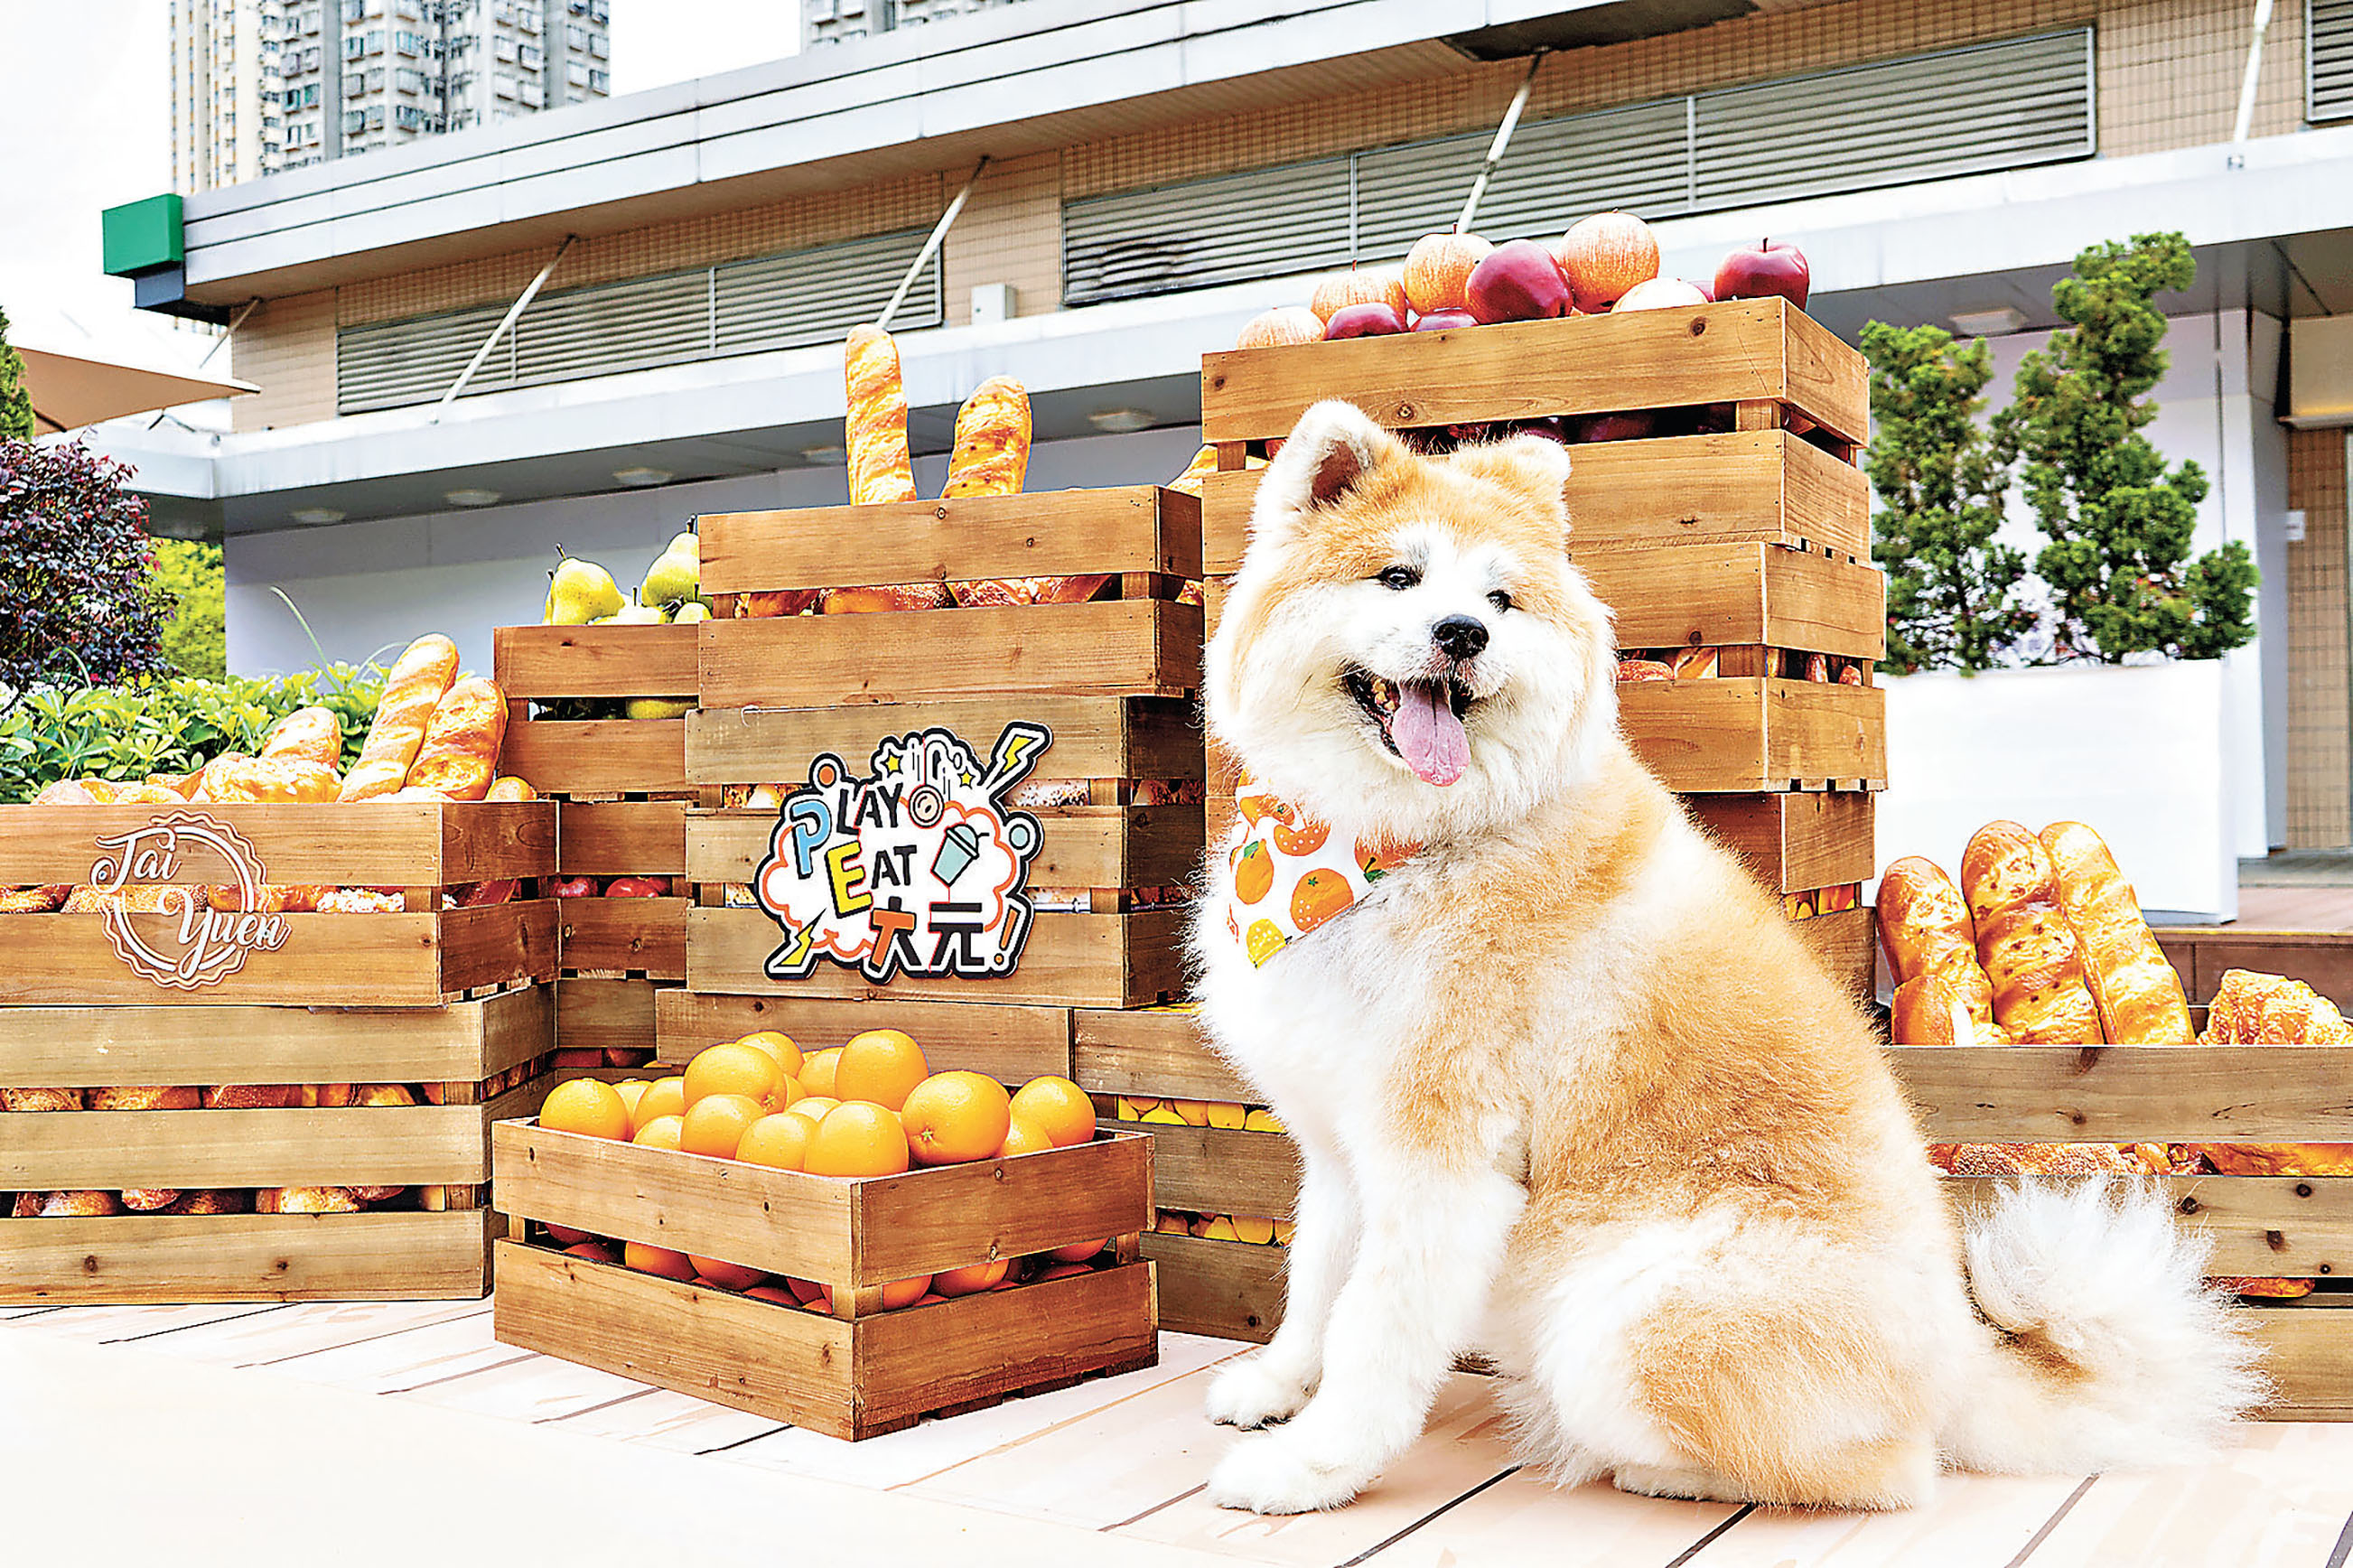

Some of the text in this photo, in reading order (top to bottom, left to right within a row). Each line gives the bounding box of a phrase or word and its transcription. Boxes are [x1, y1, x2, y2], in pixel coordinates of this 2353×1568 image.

[91, 826, 182, 894] Tai
[790, 782, 903, 880] PLAY
[824, 841, 918, 919] EAT
[157, 889, 290, 979] Yuen
